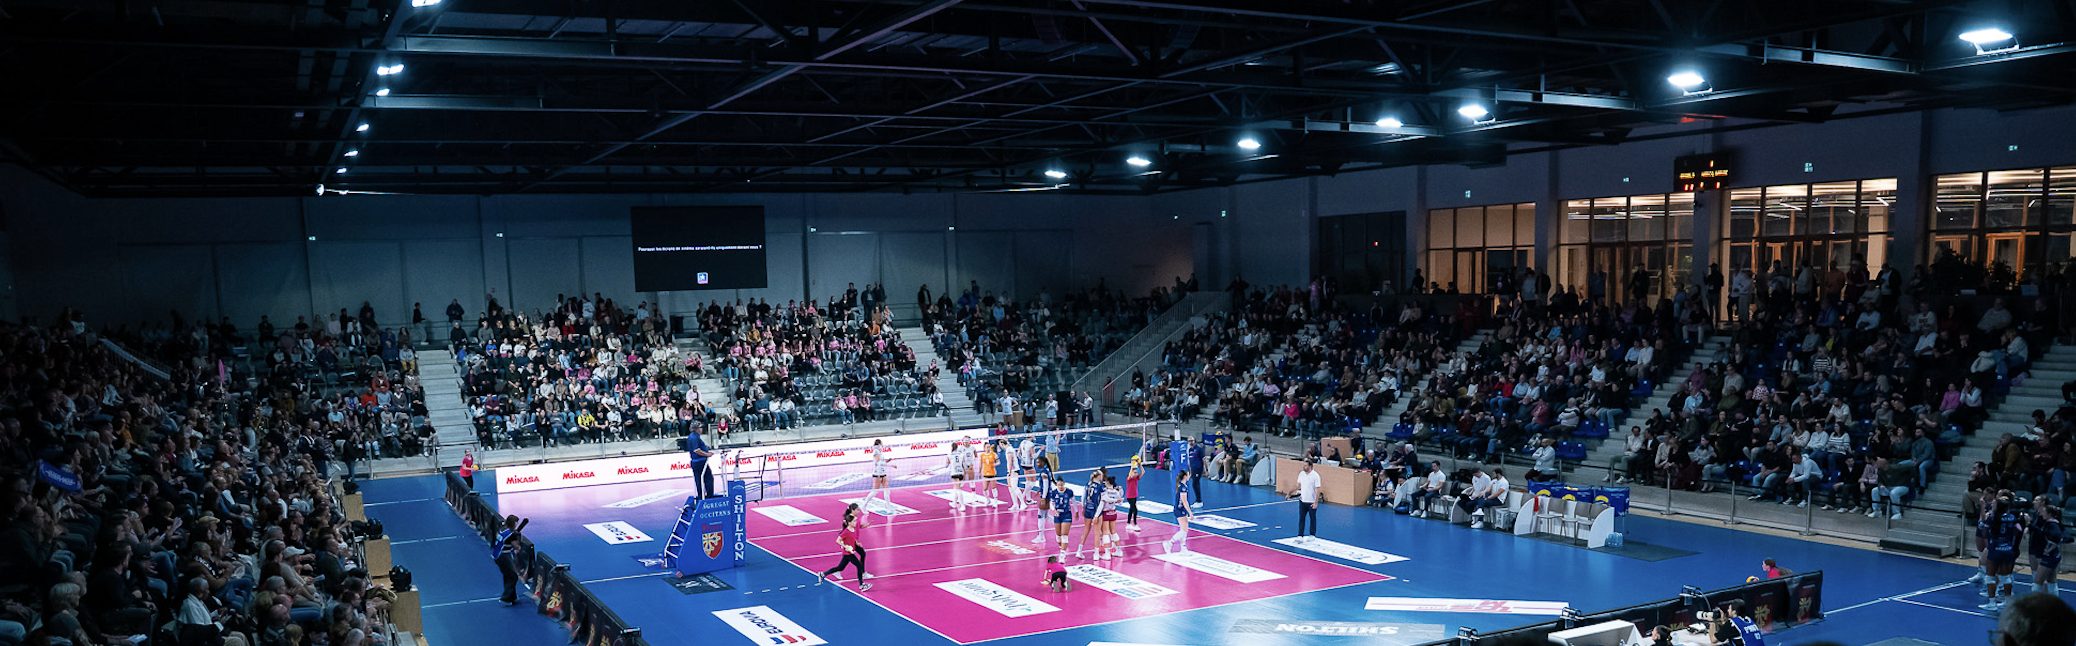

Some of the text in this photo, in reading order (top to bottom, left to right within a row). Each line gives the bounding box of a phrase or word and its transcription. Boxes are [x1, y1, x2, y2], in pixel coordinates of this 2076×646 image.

[816, 450, 845, 459] MIKASA
[1181, 453, 1186, 464] F
[562, 470, 595, 480] MIKASA
[617, 465, 649, 475] MIKASA
[506, 475, 540, 484] MIKASA
[734, 495, 745, 560] SHILTON
[739, 610, 783, 634] EUROVIA
[1276, 623, 1399, 635] SHILTON
